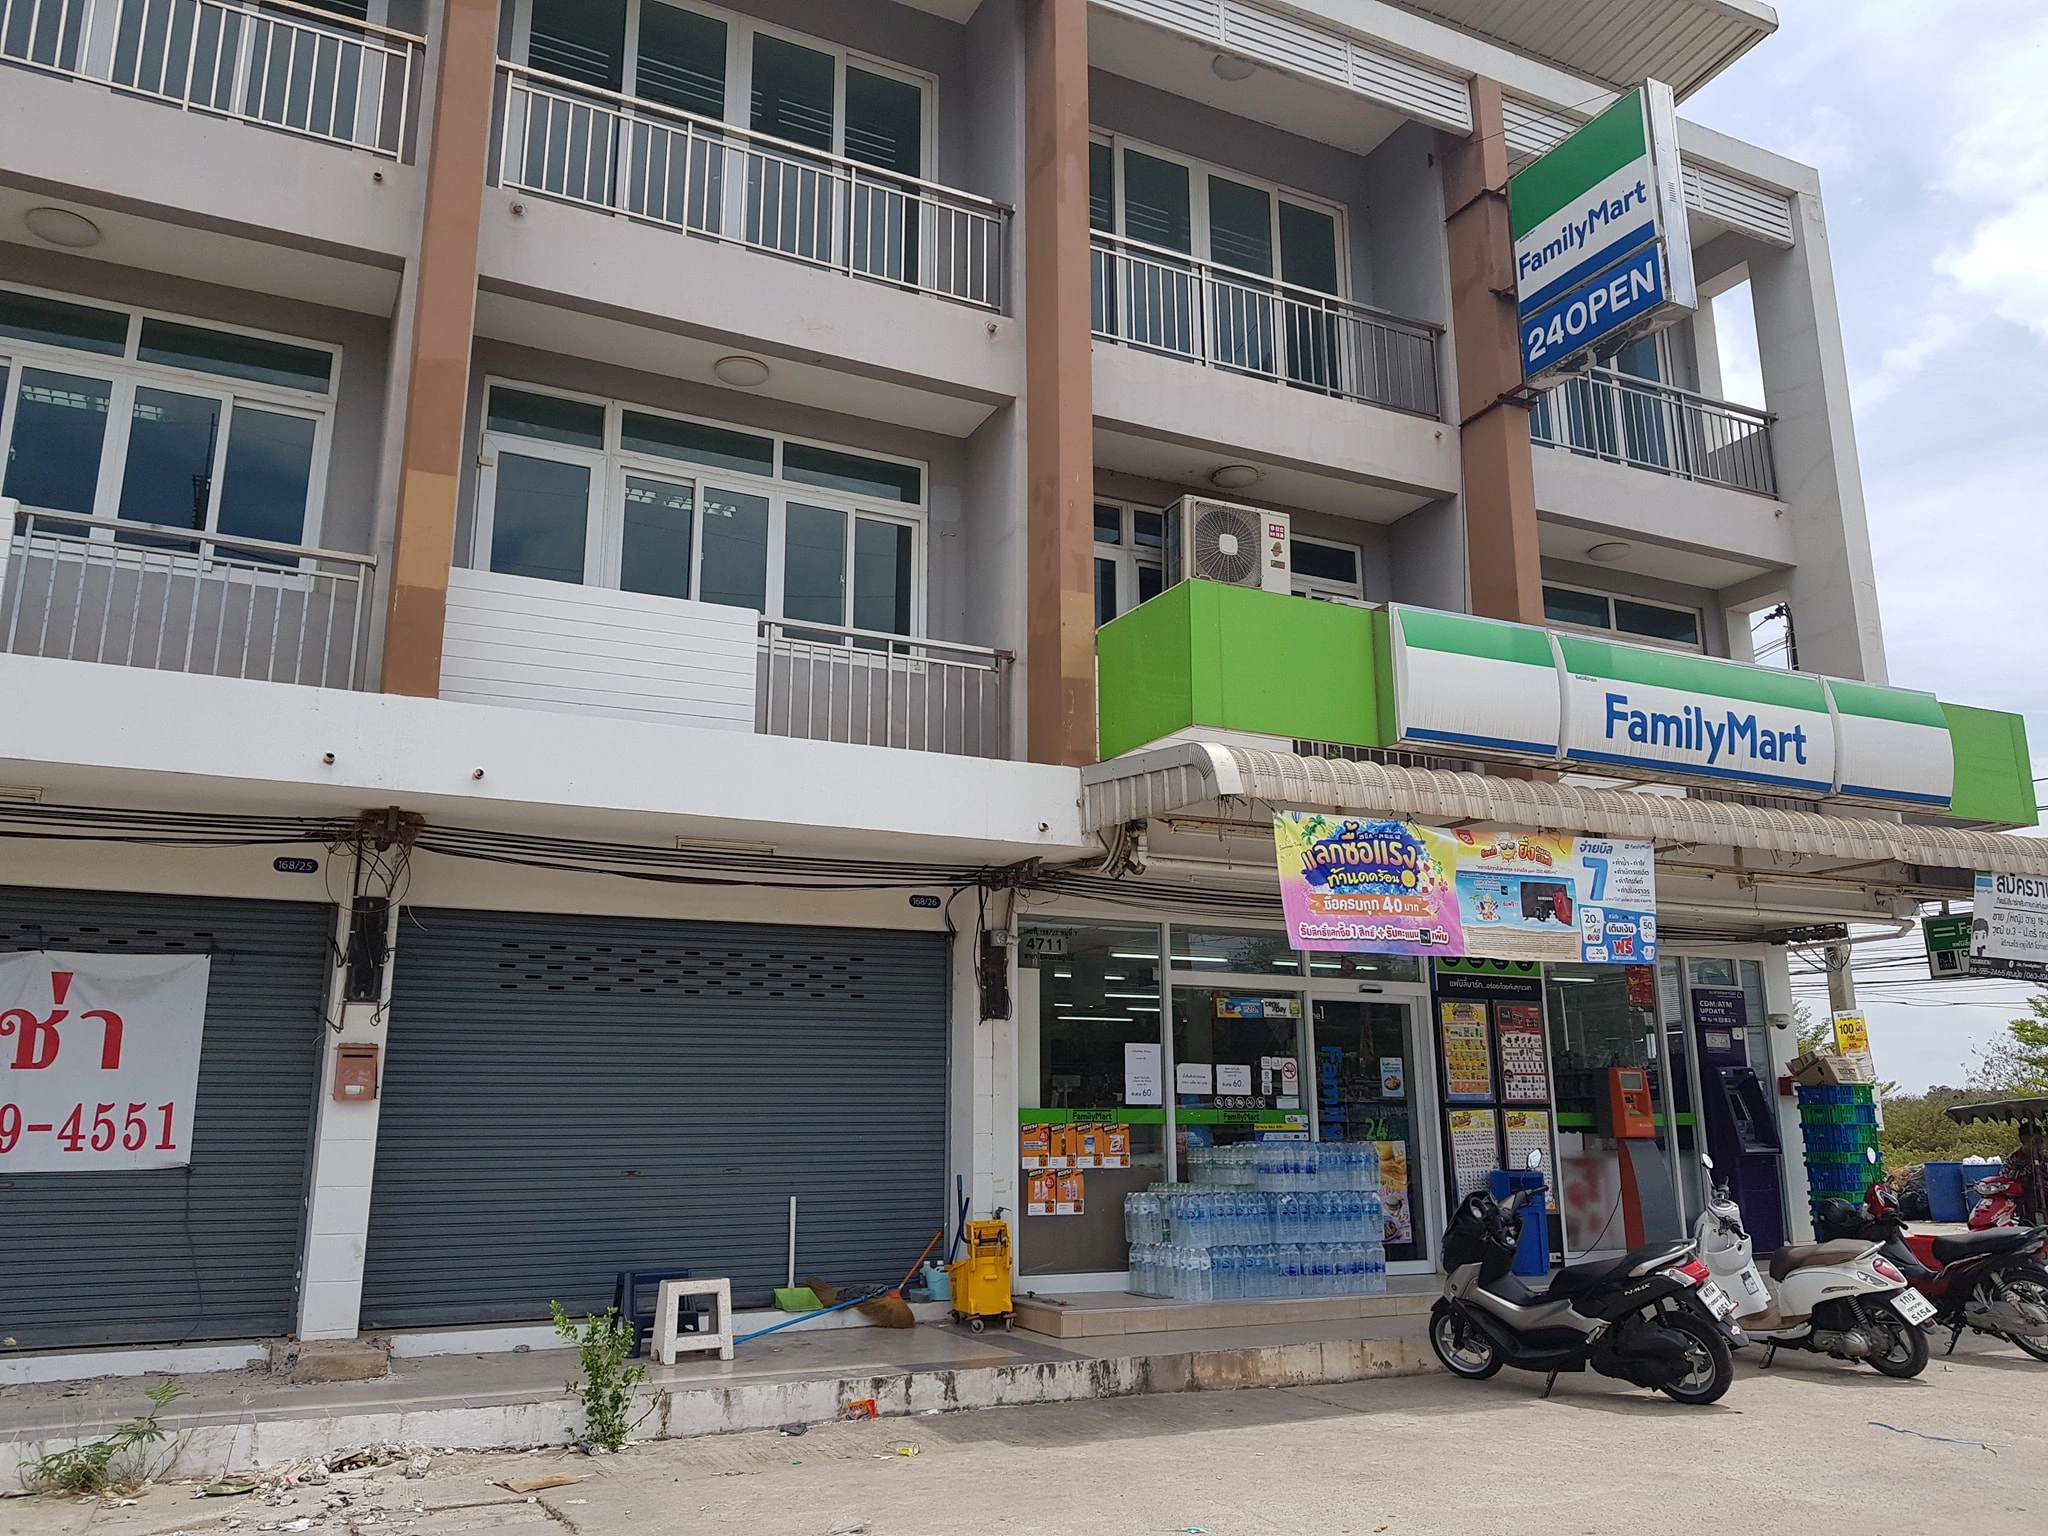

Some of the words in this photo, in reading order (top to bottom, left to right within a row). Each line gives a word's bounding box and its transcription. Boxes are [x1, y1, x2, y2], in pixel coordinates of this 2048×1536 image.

[1518, 180, 1648, 281] FamilyMart
[1604, 693, 1807, 765] FamilyMart
[1301, 820, 1417, 871] แลกซื้อแรง
[1518, 836, 1535, 861] ยิ่ง
[1579, 840, 1614, 854] จ่ายบิล
[278, 860, 313, 871] 168/25
[1328, 866, 1400, 888] ท้าแดดร้อน
[1582, 855, 1608, 902] 7
[912, 896, 938, 907] 168/26
[1323, 896, 1380, 915] ซื้อครบทุก
[1382, 896, 1402, 913] 40
[1404, 903, 1419, 912] บาท
[1584, 914, 1597, 924] 20
[1643, 921, 1652, 930] 50
[1386, 926, 1419, 939] รับคะแนน
[1432, 926, 1448, 942] เพิ่ม
[1608, 923, 1634, 934] เติมเงิน
[1026, 937, 1062, 951] 4711
[1613, 936, 1633, 955] ฟรี
[1699, 1000, 1733, 1008] CDM/ATM
[1839, 1023, 1854, 1034] 100
[1233, 1079, 1242, 1088] 60
[1142, 1088, 1152, 1097] 60
[1072, 1111, 1113, 1121] FamilyMart
[1223, 1112, 1260, 1121] FamilyMart
[1365, 1118, 1388, 1141] 24
[1911, 1306, 1932, 1322] 5154
